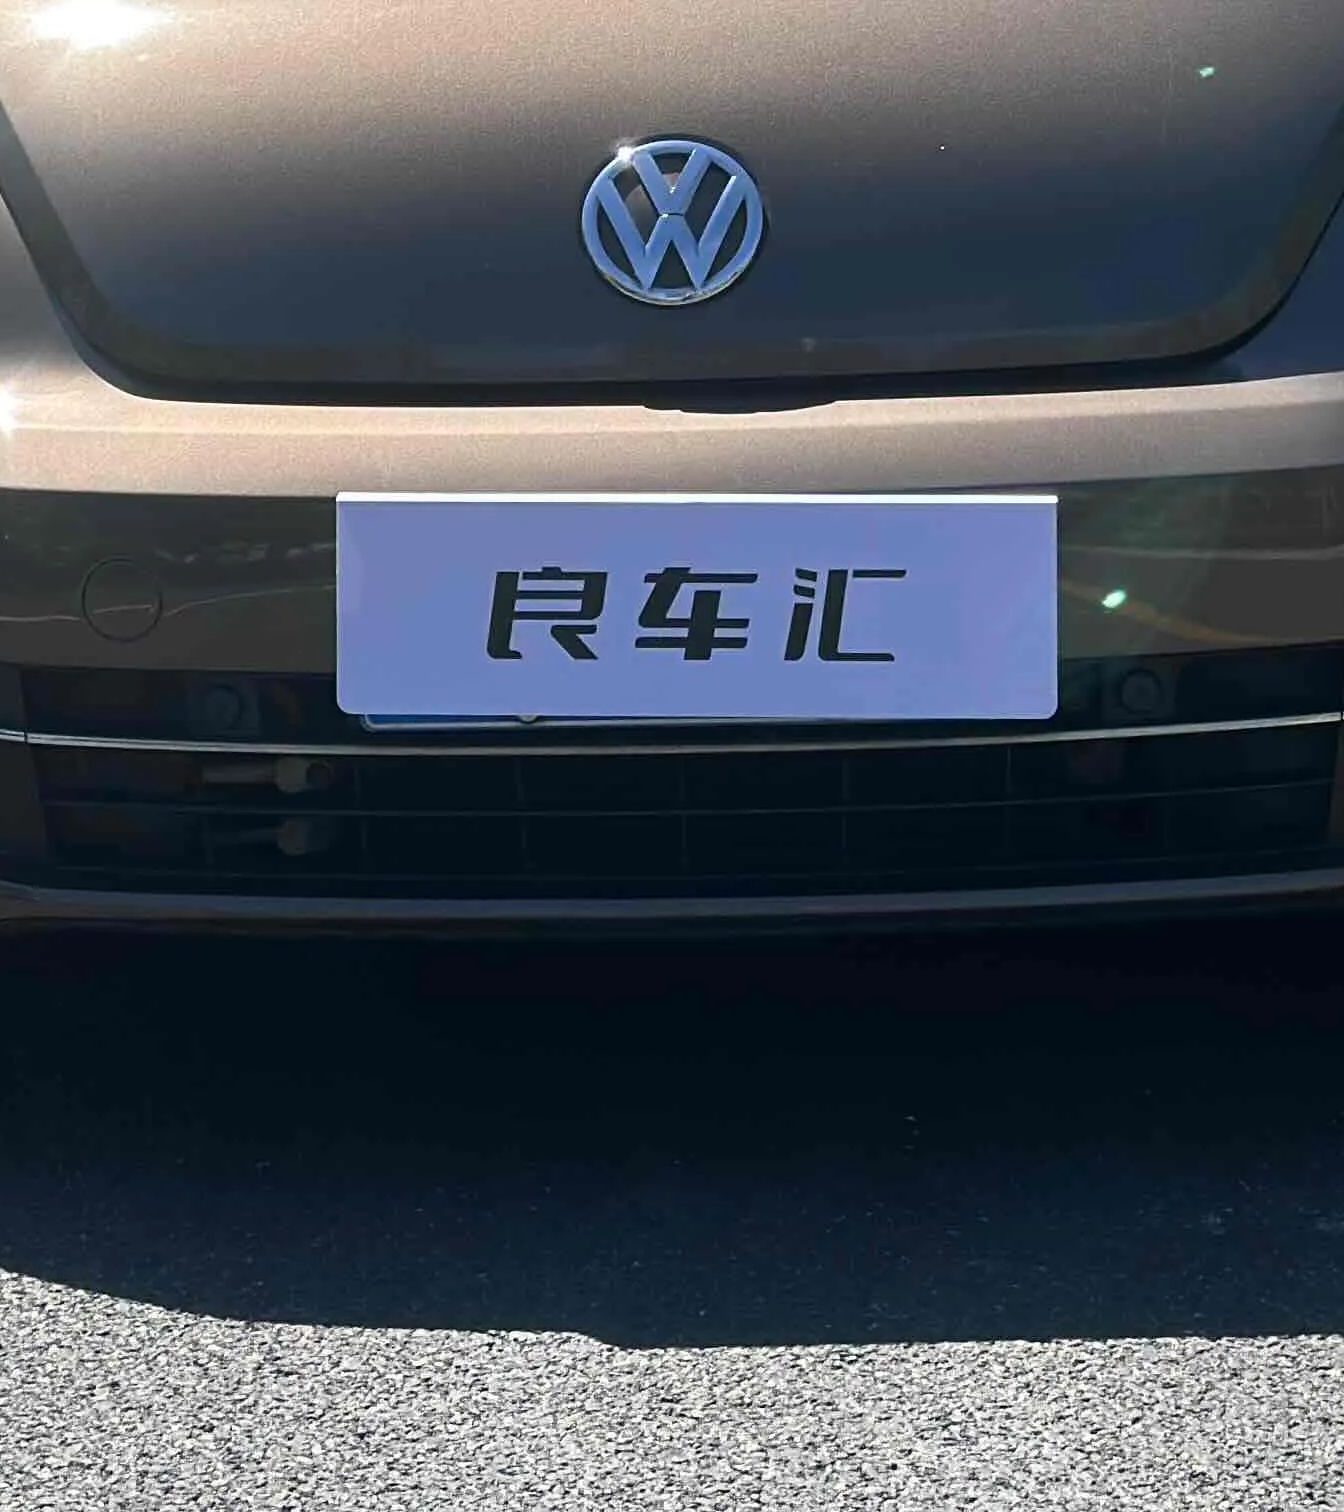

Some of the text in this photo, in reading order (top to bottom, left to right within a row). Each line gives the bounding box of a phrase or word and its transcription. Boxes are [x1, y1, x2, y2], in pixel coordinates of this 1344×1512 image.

[586, 141, 760, 301] VW
[486, 566, 907, 663] 良车汇
